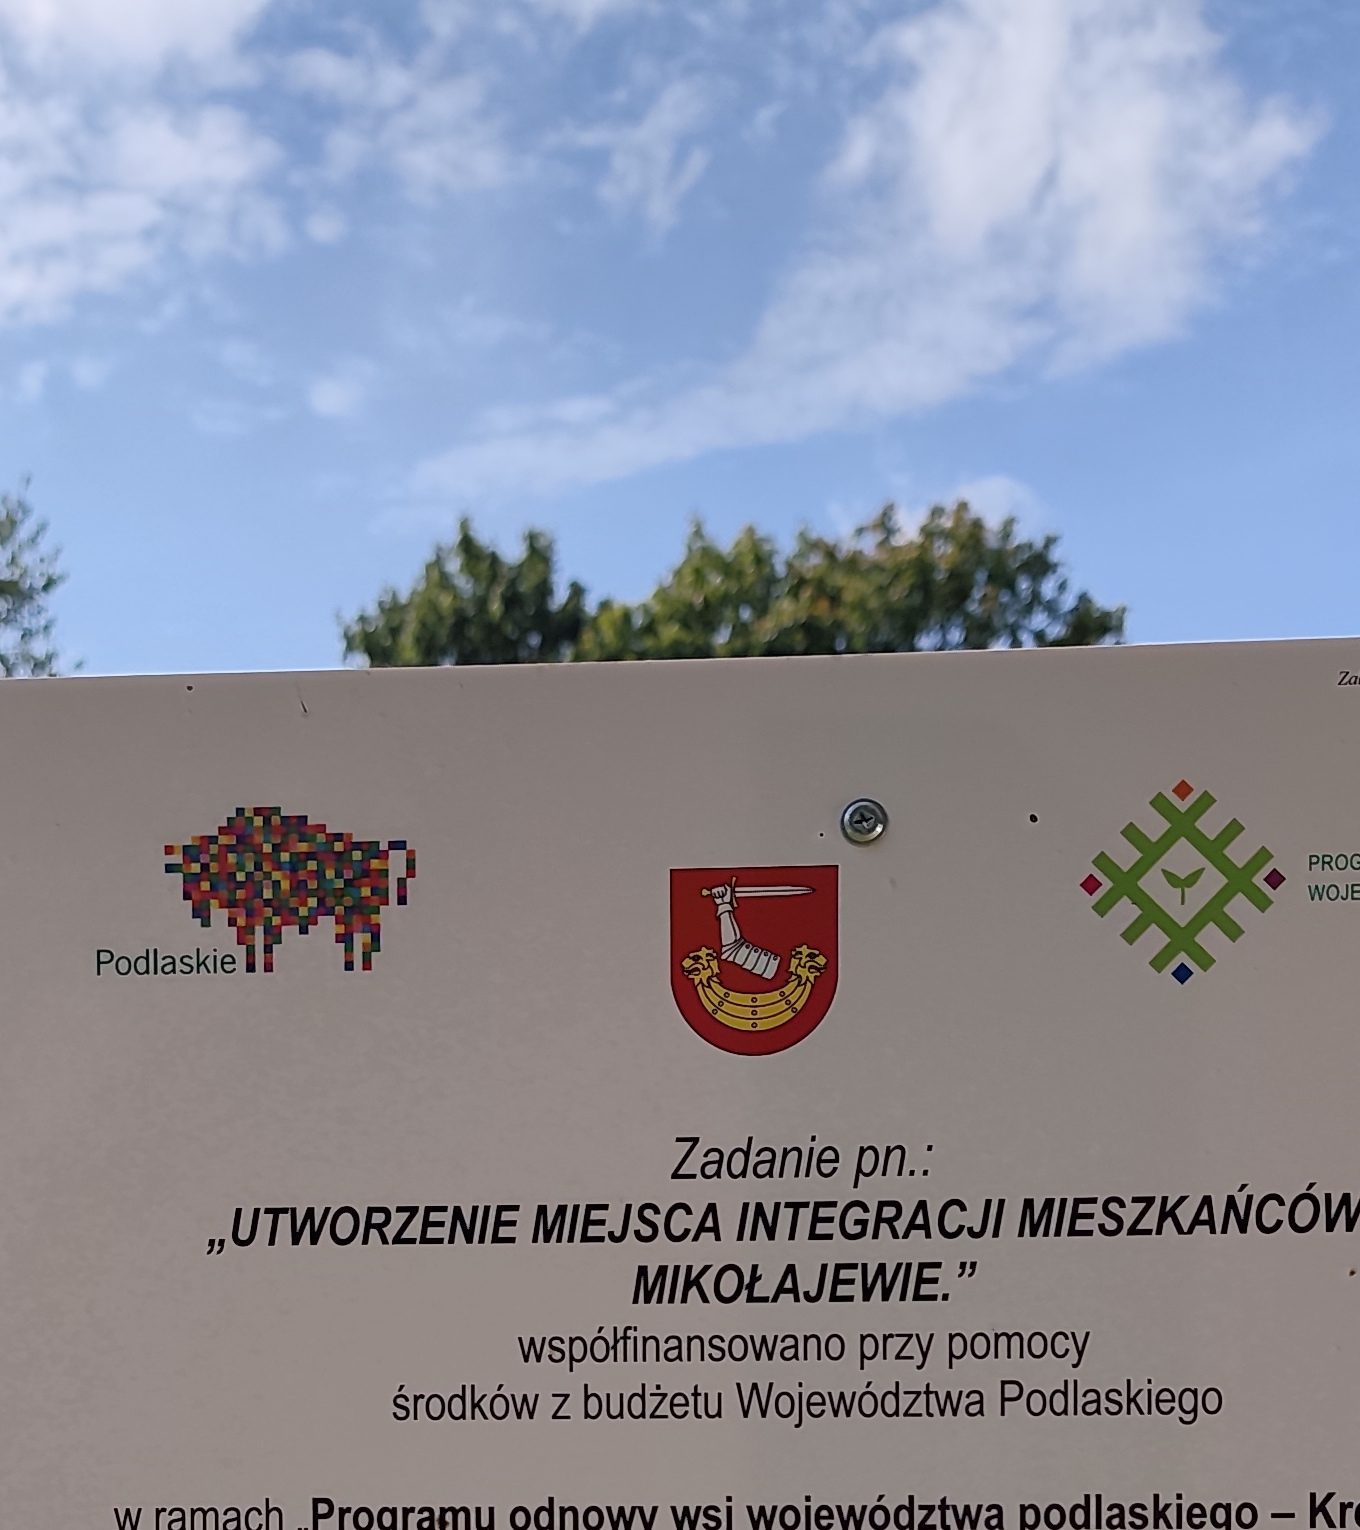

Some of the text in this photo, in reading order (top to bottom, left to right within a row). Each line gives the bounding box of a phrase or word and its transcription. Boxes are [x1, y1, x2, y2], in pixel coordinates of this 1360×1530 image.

[96, 948, 237, 976] Podlaskie
[671, 1135, 933, 1189] Zadanie pn.:
[207, 1205, 520, 1255] „UTWORZENIE
[532, 1202, 721, 1243] MIEJSCA
[736, 1199, 1006, 1241] INTEGRACJI
[632, 1261, 978, 1304] MIKOŁAJEWIE.”
[518, 1326, 1090, 1372] współfinansowano przy pomocy
[393, 1379, 1222, 1428] środków z budżetu Województwa Podlaskiego
[670, 1496, 732, 1530] wsi
